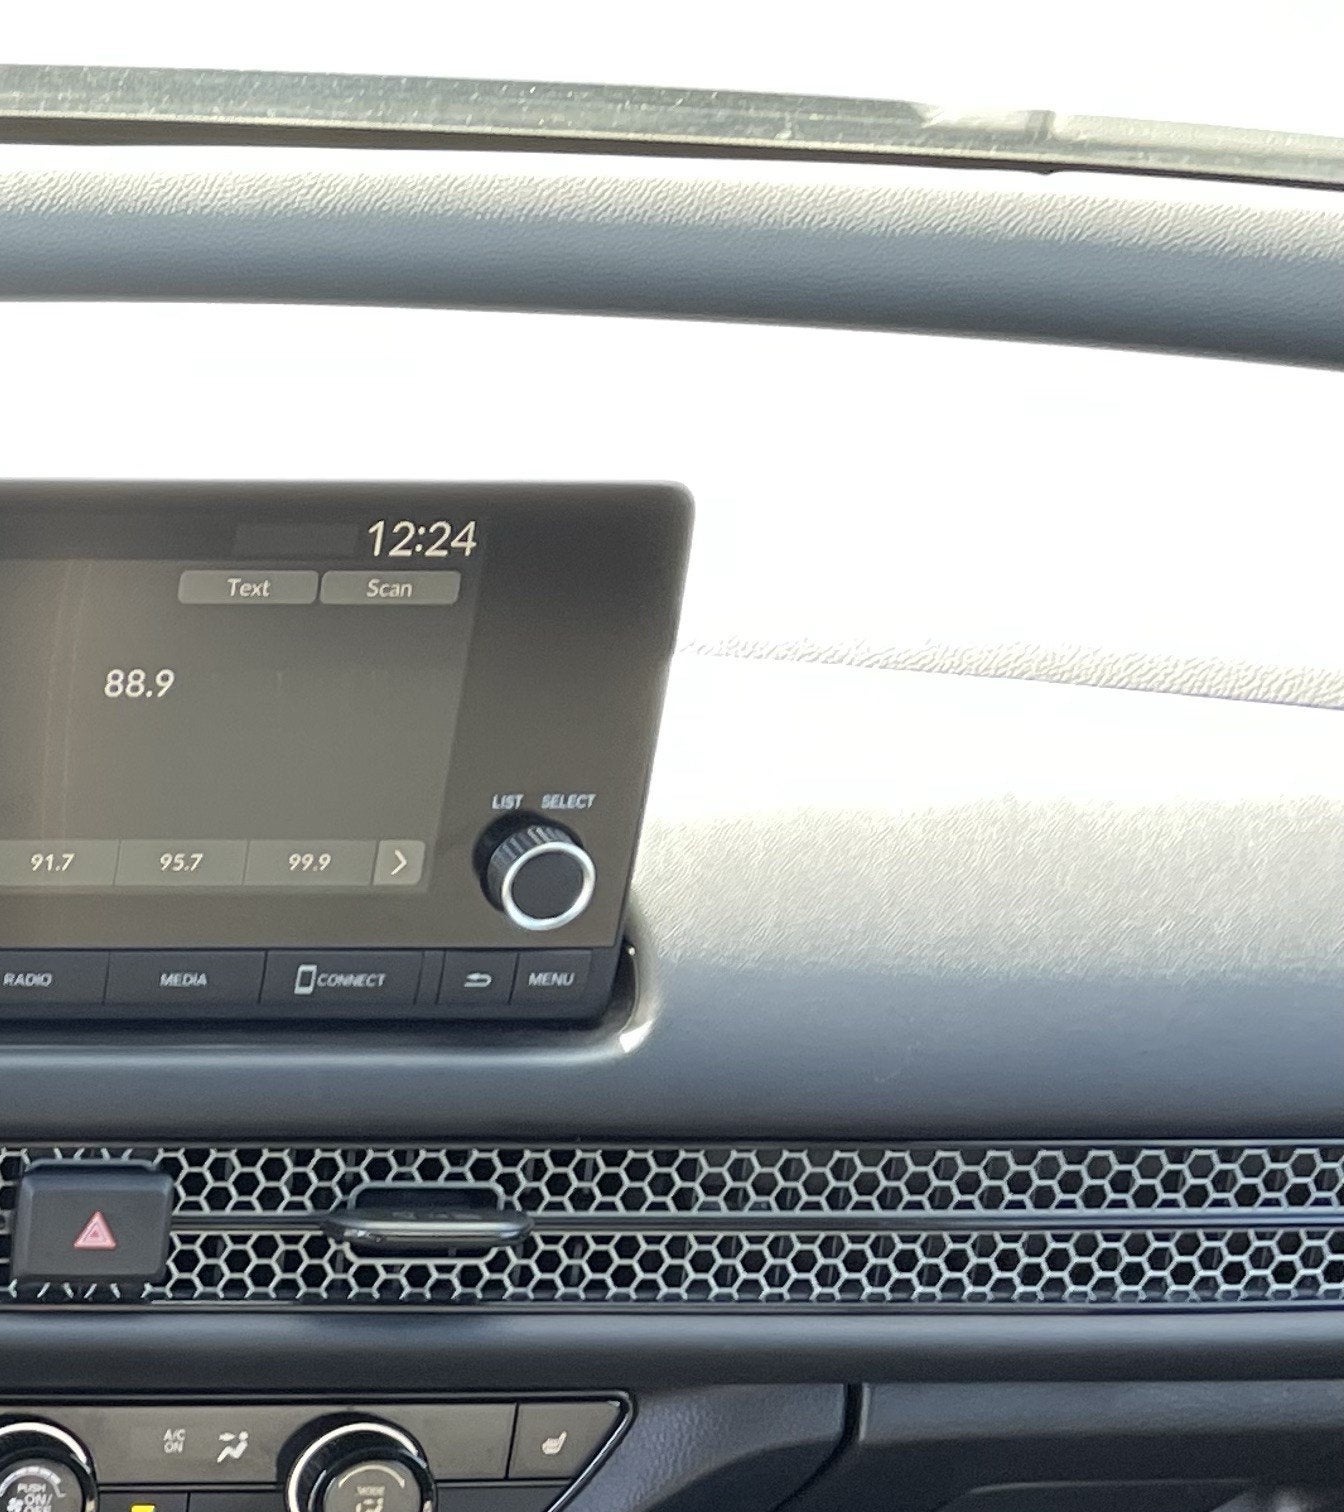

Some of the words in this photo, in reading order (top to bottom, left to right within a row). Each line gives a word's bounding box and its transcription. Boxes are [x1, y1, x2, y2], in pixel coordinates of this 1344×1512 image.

[368, 521, 478, 557] 12:24
[227, 578, 272, 598] Text
[366, 579, 413, 598] Scan
[104, 669, 175, 700] 88.9
[491, 794, 524, 811] LIST
[541, 793, 597, 811] SELECT
[30, 853, 75, 873] 91.7
[159, 852, 203, 872] 95.7
[287, 852, 332, 872] 99.9
[3, 973, 52, 988] RADIO
[160, 971, 207, 987] MEDIA
[317, 970, 386, 989] CONNECT
[528, 970, 575, 987] MENU
[163, 1428, 187, 1442] A/C
